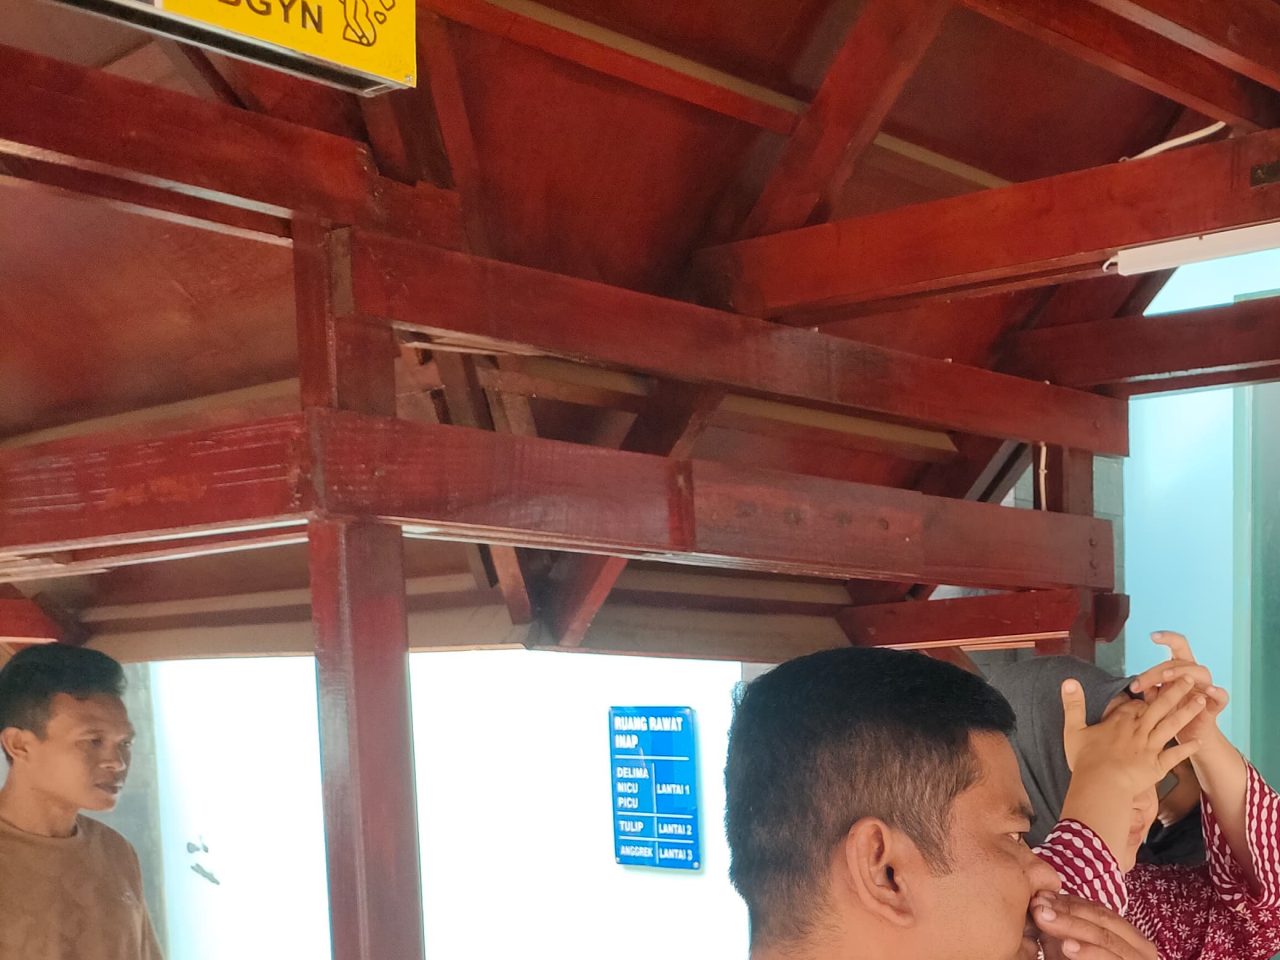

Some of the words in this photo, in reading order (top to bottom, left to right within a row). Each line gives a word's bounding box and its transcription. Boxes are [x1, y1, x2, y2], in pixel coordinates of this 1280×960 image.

[217, 0, 323, 34] GYN
[614, 716, 648, 731] RUANG
[649, 716, 683, 732] RAWAT
[615, 734, 639, 749] INAP
[616, 766, 649, 779] DELIMA
[616, 782, 638, 794] NICU
[656, 783, 684, 795] LANTAI
[684, 785, 690, 795] 1
[616, 796, 638, 809] PICU
[619, 820, 644, 832] TULIP
[658, 823, 685, 835] LANTAI
[686, 825, 692, 835] 2
[620, 845, 653, 858] ANGGREK
[659, 848, 686, 860] LANTAI
[687, 849, 693, 861] 3
